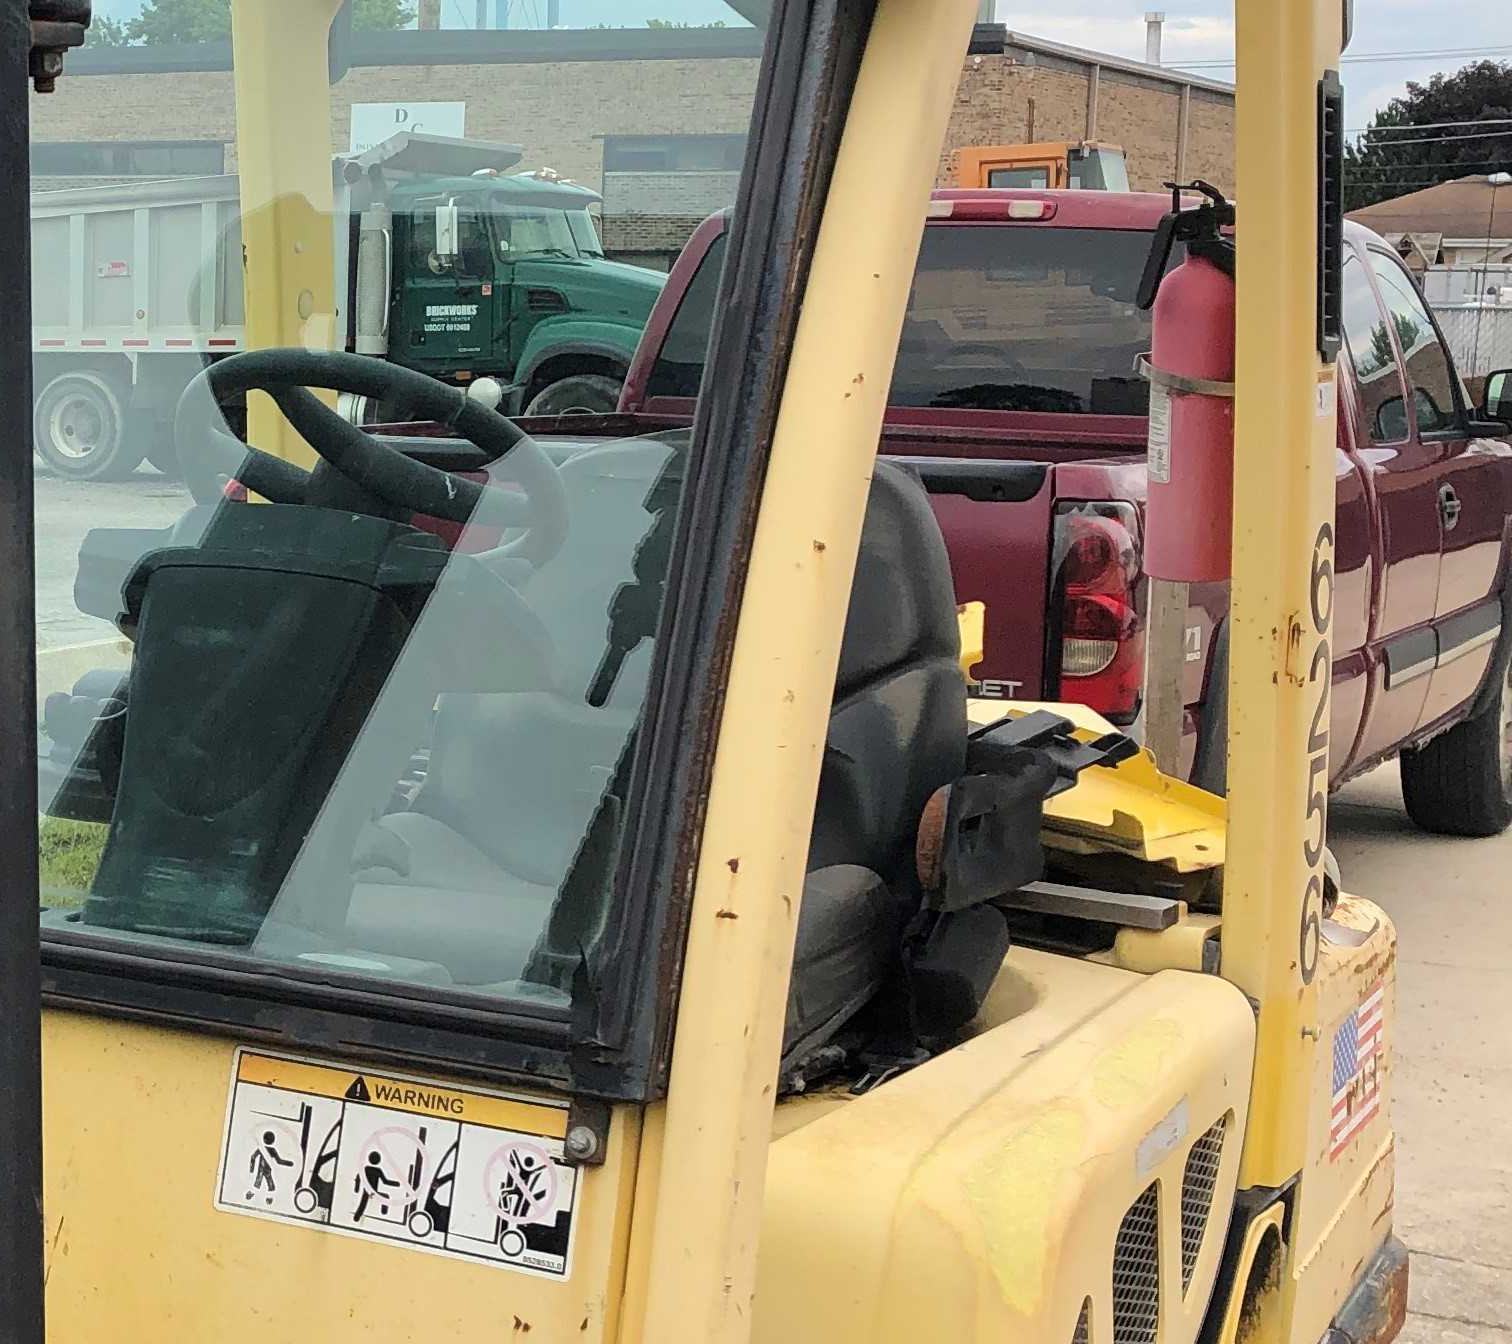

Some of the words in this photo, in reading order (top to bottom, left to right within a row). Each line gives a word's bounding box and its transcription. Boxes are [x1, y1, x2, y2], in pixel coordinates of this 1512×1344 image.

[425, 304, 479, 317] BRICKWORKS
[1299, 522, 1333, 985] 6256
[375, 1083, 465, 1114] WARNING
